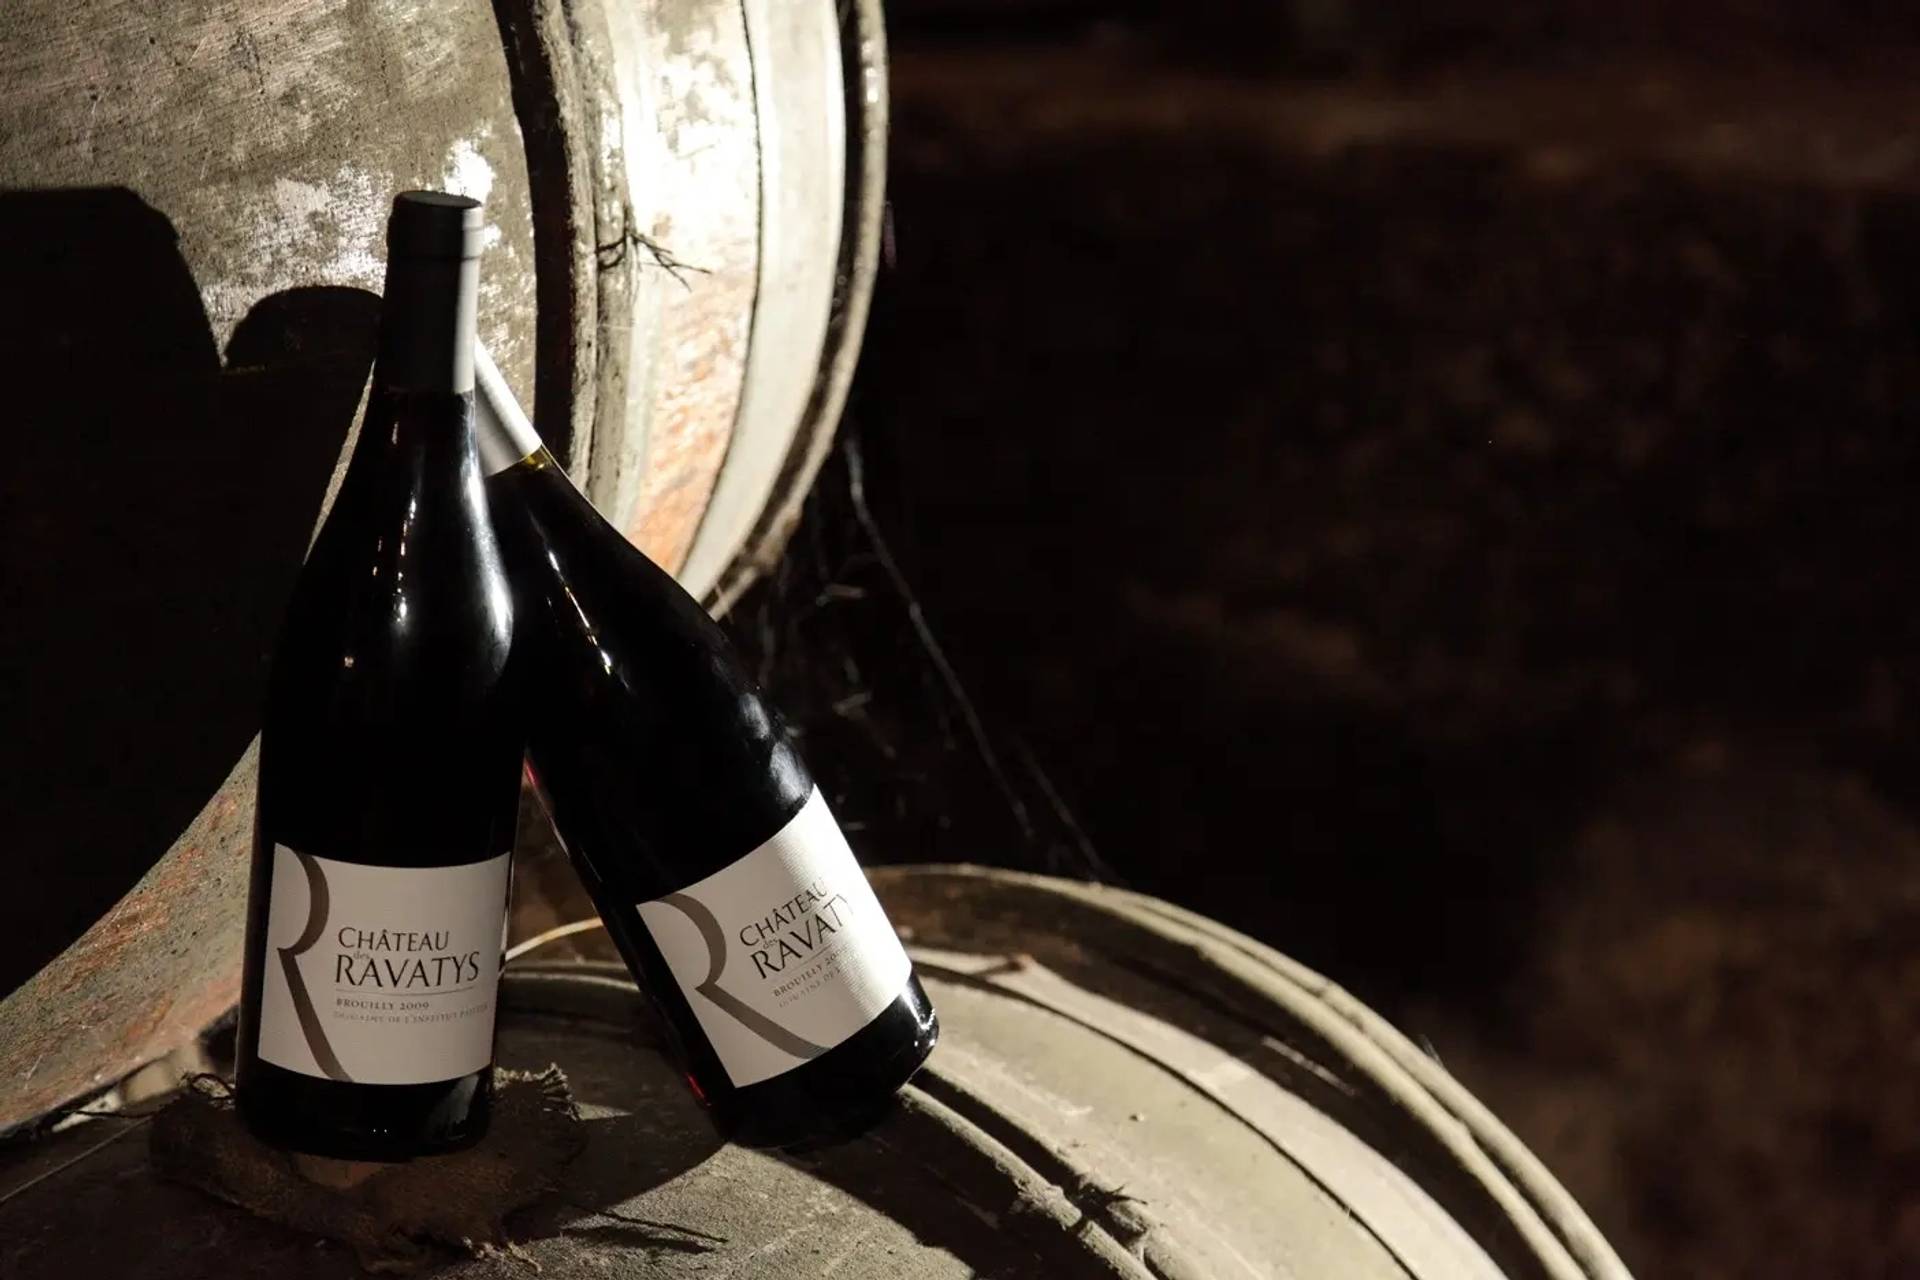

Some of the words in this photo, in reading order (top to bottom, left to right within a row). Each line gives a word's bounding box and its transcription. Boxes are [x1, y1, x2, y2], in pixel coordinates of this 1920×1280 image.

[739, 876, 828, 947] CHÂTEAU
[338, 926, 450, 952] CHÂTEAU
[762, 937, 778, 950] des
[353, 949, 370, 960] des
[335, 950, 480, 988] RAVATYS
[773, 963, 822, 997] BROUILLY
[336, 997, 394, 1011] BROUILLY
